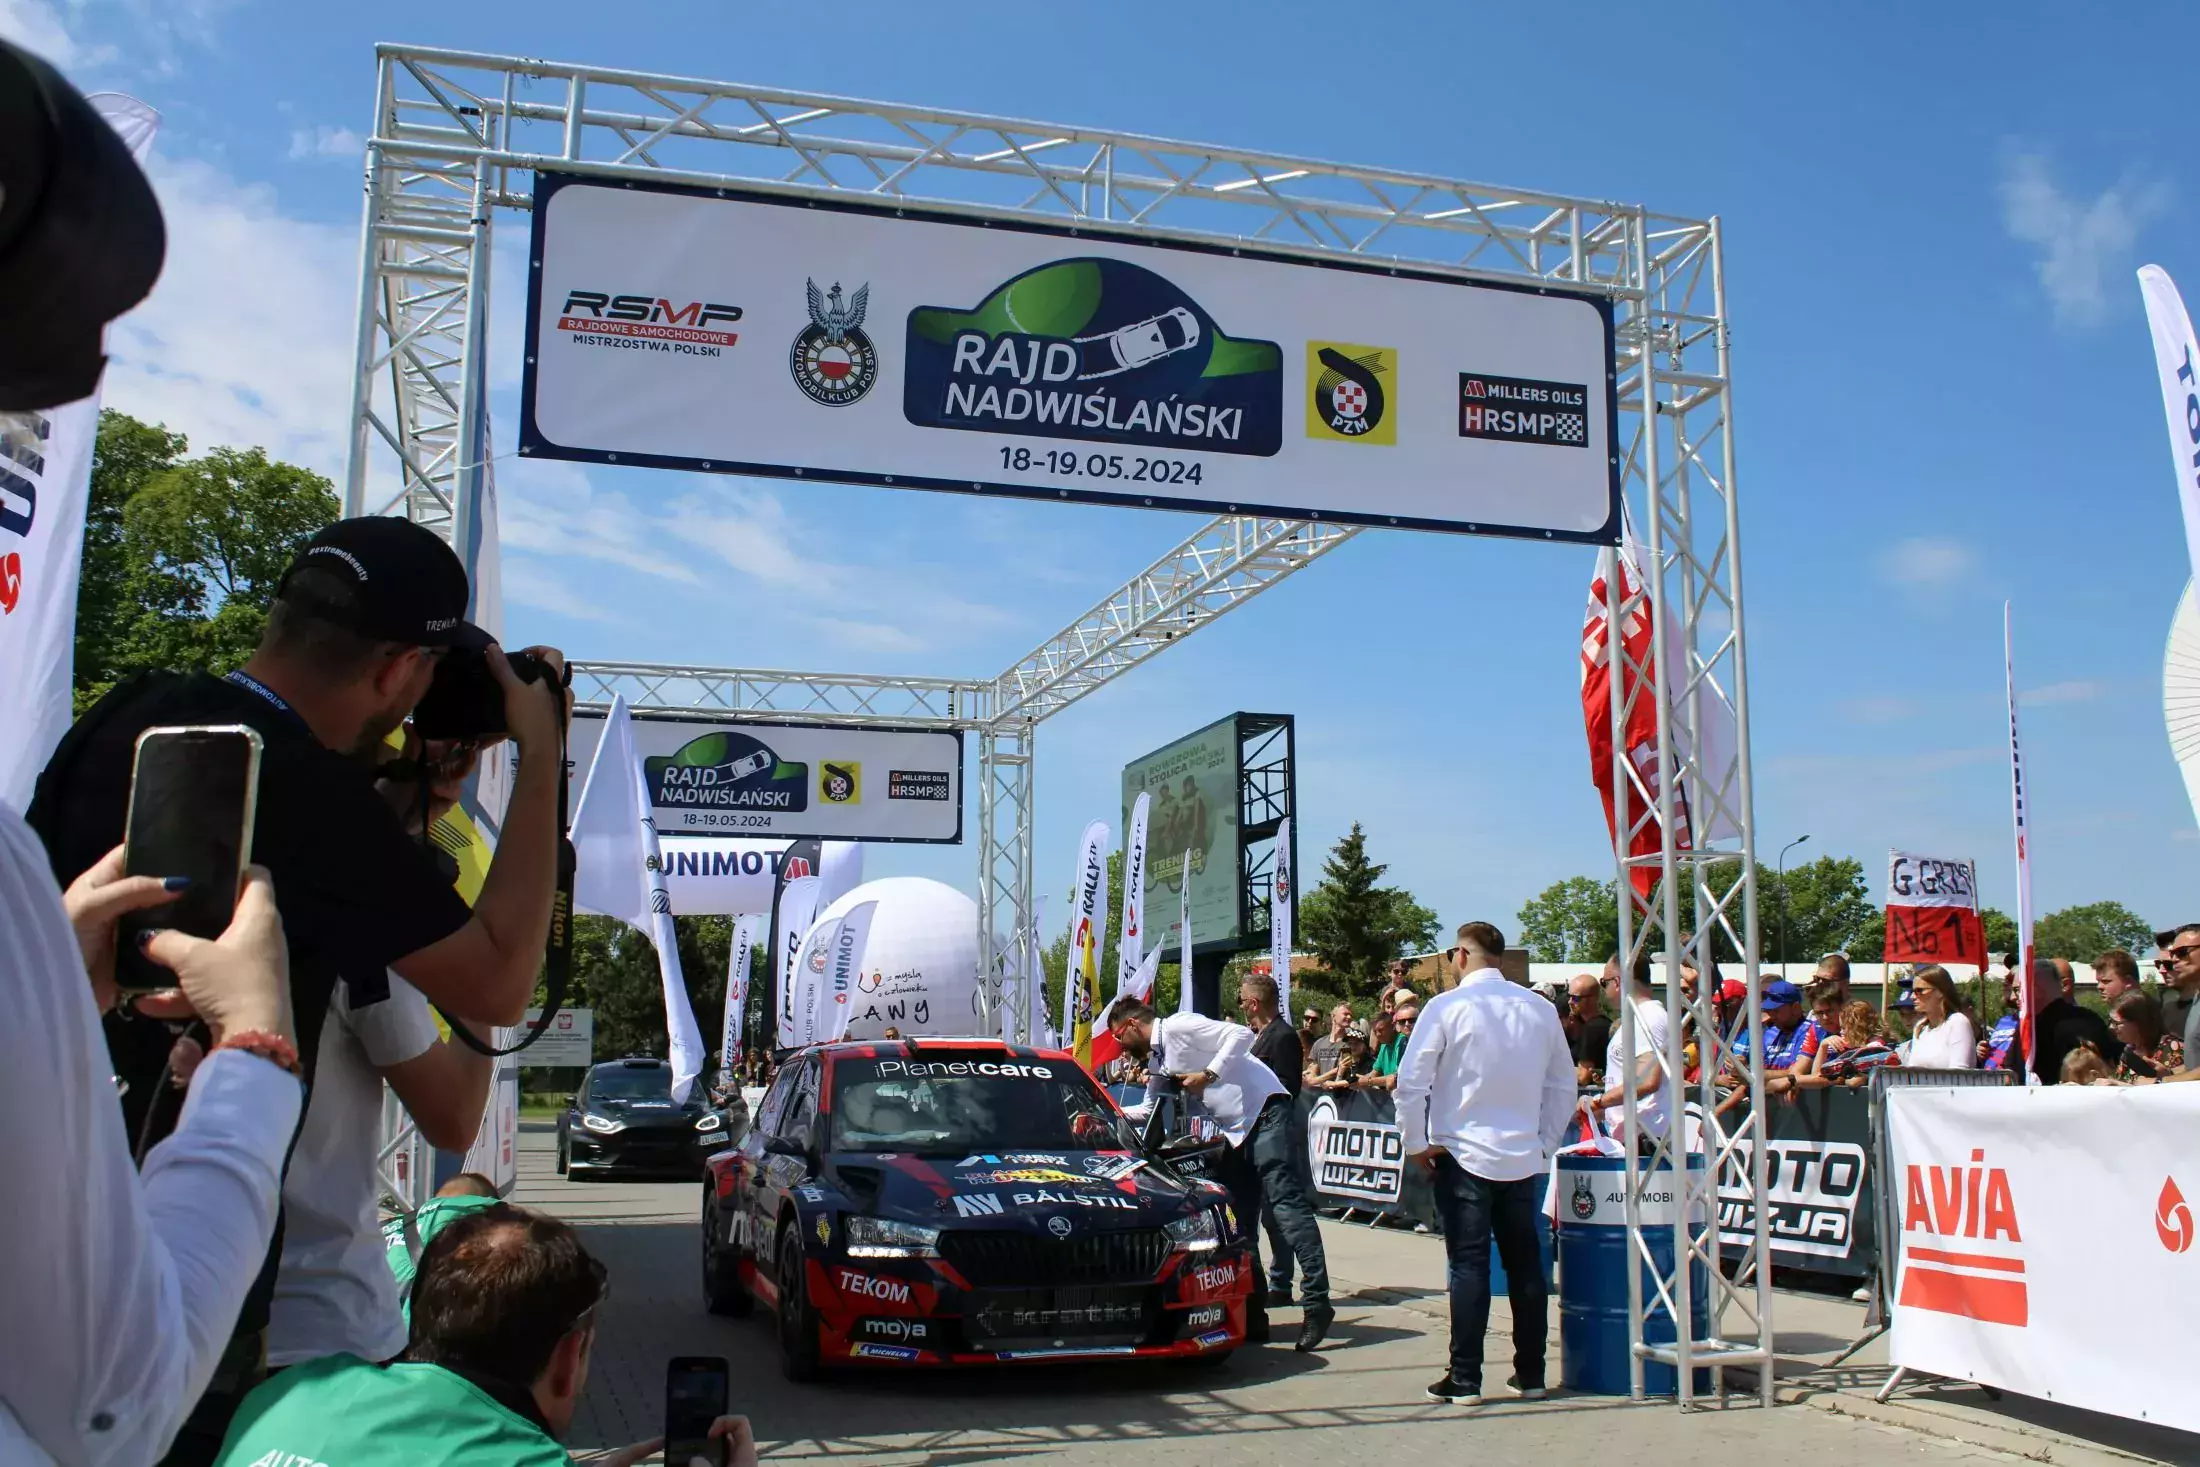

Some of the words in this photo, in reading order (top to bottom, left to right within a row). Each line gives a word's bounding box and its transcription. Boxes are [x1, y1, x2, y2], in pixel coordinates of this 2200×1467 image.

[562, 290, 744, 328] RSMP
[567, 319, 629, 336] RAJDOWE
[632, 324, 729, 344] SAMOCHODOWE
[573, 333, 670, 353] MISTRZOSTWA
[674, 343, 721, 358] POLSKI
[794, 339, 859, 403] AUTOMOBILKLUB
[860, 344, 876, 389] POLSKI
[952, 334, 1078, 385] RAJD
[1488, 384, 1549, 402] MILLERS
[1552, 390, 1583, 406] OILS
[945, 382, 1243, 440] NADWIŚLAŃSKI
[1465, 404, 1556, 436] HRSMP
[1331, 414, 1369, 434] PZM
[1000, 447, 1203, 486] 18-19.05.2024
[663, 766, 718, 787] RAJD
[660, 786, 791, 807] NADWIŚLAŃSKI
[891, 785, 934, 797] HRSMP
[683, 813, 772, 827] 18-19.05.2024
[1151, 848, 1202, 872] TRENIG
[835, 924, 856, 992] UNIMOT
[875, 1061, 1053, 1079] iPlanetcare
[1326, 1126, 1403, 1161] MOTO
[1323, 1165, 1397, 1191] WIZJA
[1013, 1189, 1139, 1210] BÅLSTIL
[841, 1271, 910, 1304] TEKOM
[1196, 1264, 1235, 1291] TEKOM
[1188, 1306, 1222, 1328] moya
[865, 1318, 927, 1343] moya
[869, 1348, 911, 1358] MICHELIN
